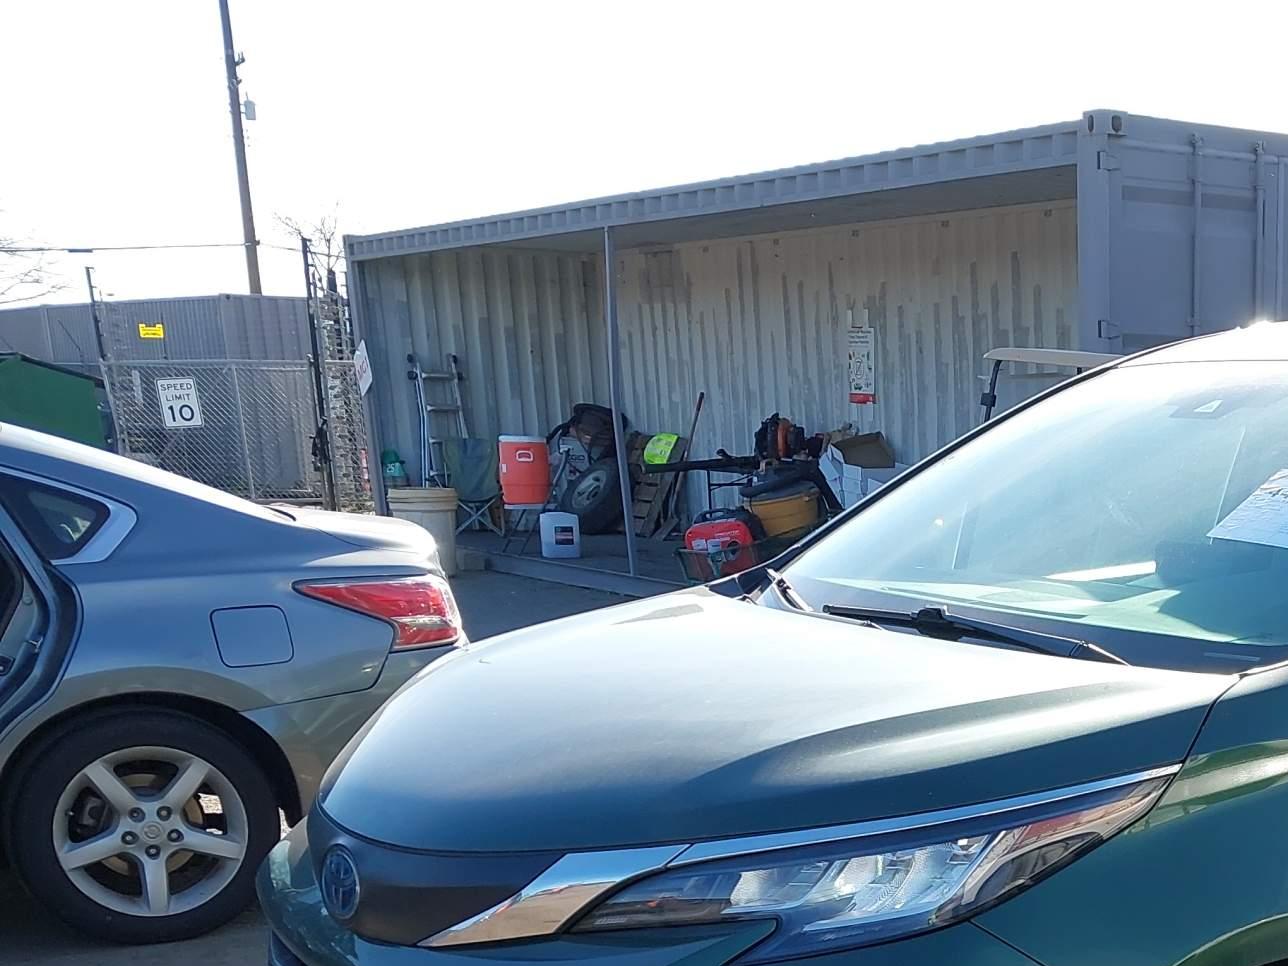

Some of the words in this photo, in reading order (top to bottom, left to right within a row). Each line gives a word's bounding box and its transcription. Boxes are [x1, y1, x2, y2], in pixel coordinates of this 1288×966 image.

[160, 383, 192, 392] SPEED
[165, 393, 191, 402] LIMIT
[167, 404, 195, 423] 10
